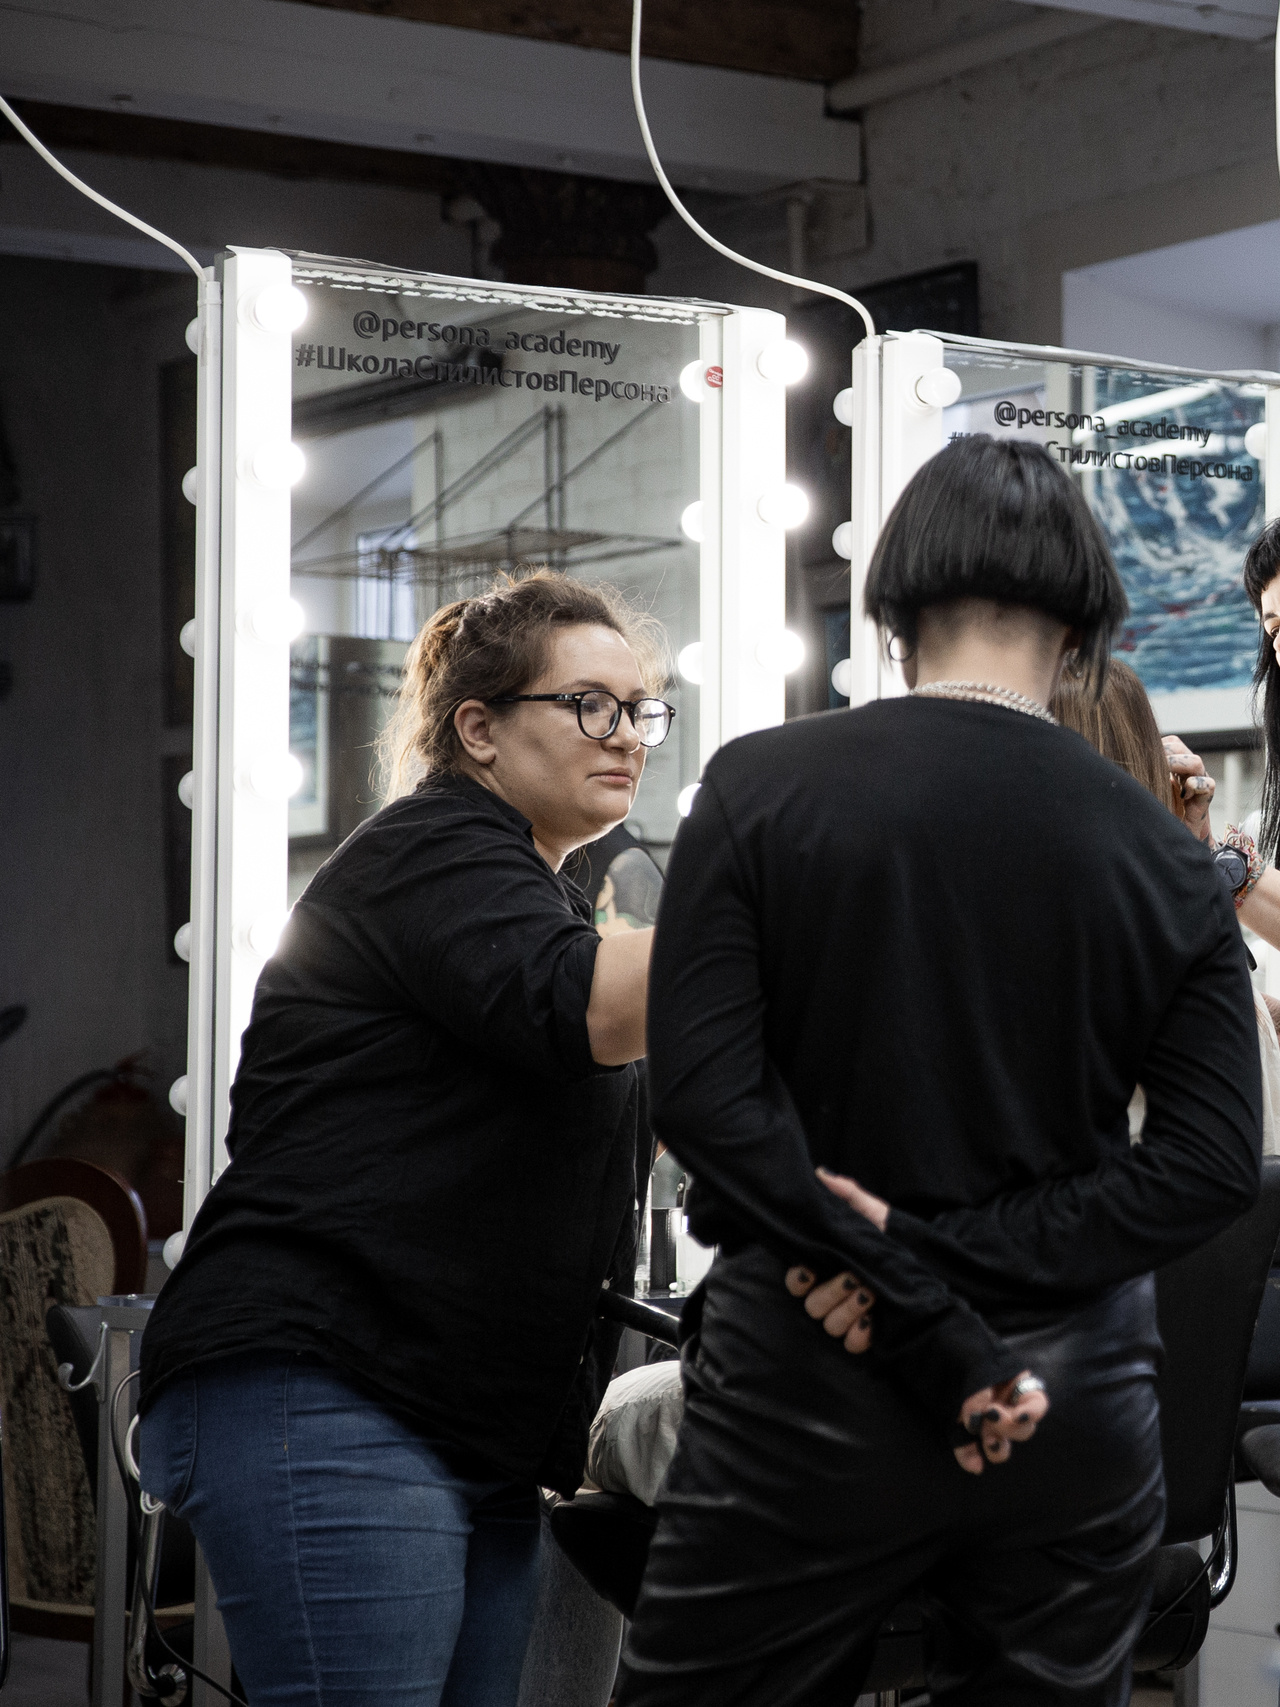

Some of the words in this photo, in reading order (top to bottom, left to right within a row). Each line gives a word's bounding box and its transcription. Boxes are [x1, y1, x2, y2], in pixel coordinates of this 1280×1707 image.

[353, 310, 621, 364] @persona_academy
[295, 343, 673, 404] #ШколаСтилистовПерсона
[994, 400, 1212, 447] @persona_academy
